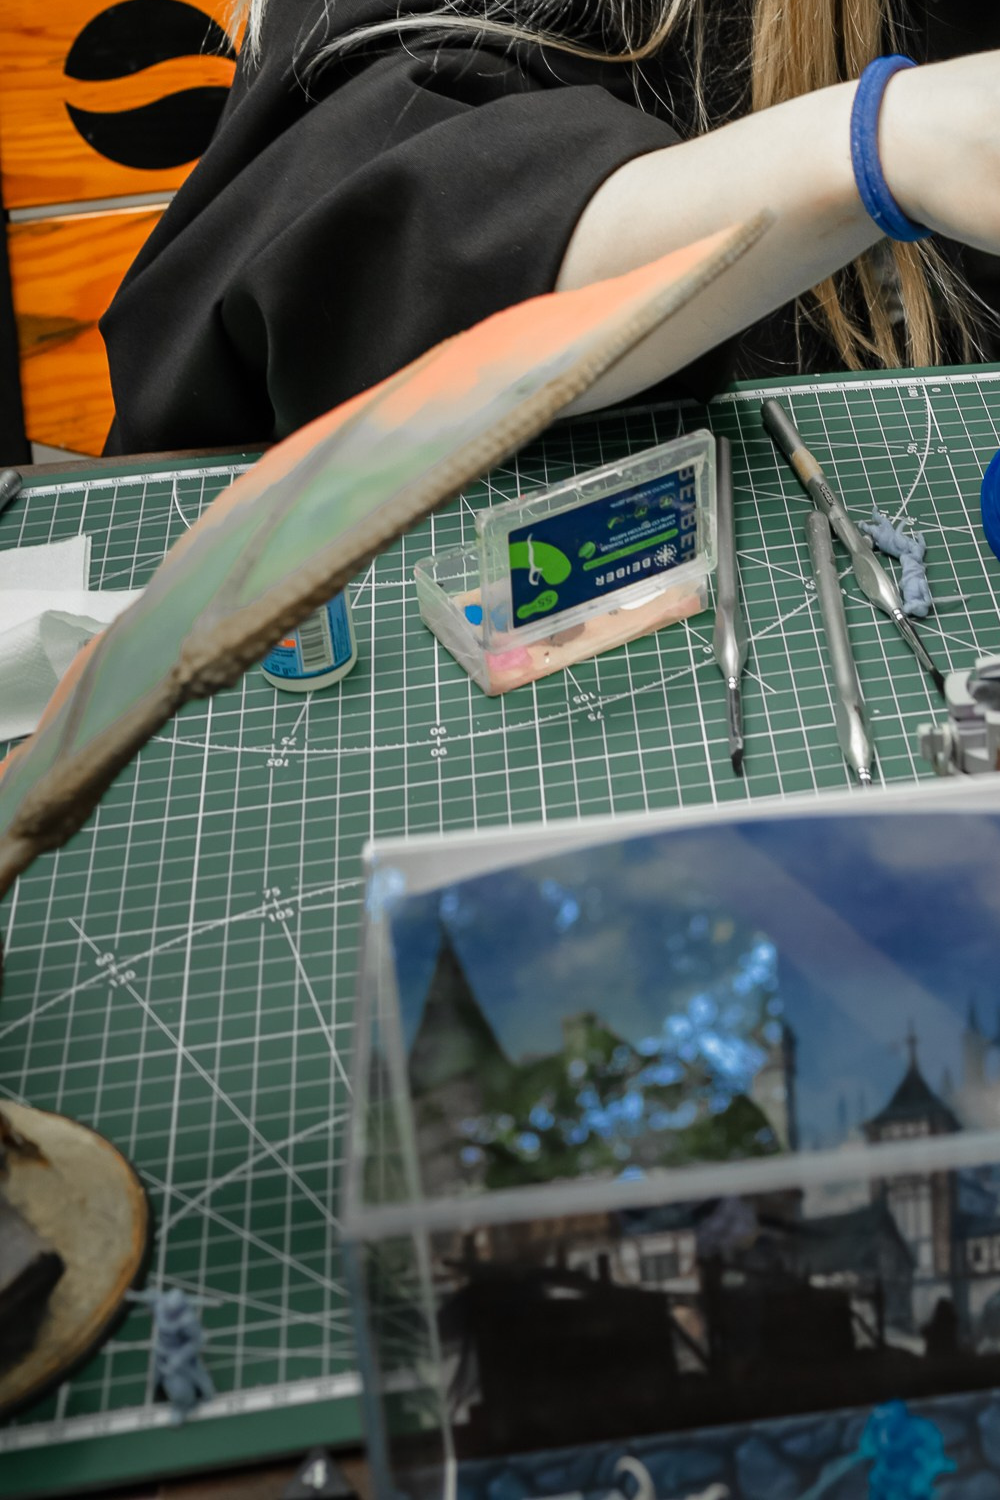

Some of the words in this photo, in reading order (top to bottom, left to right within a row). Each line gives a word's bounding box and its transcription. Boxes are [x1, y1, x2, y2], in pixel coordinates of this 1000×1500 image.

[594, 558, 652, 586] BEIBER
[263, 886, 281, 899] 75
[268, 907, 295, 922] 105
